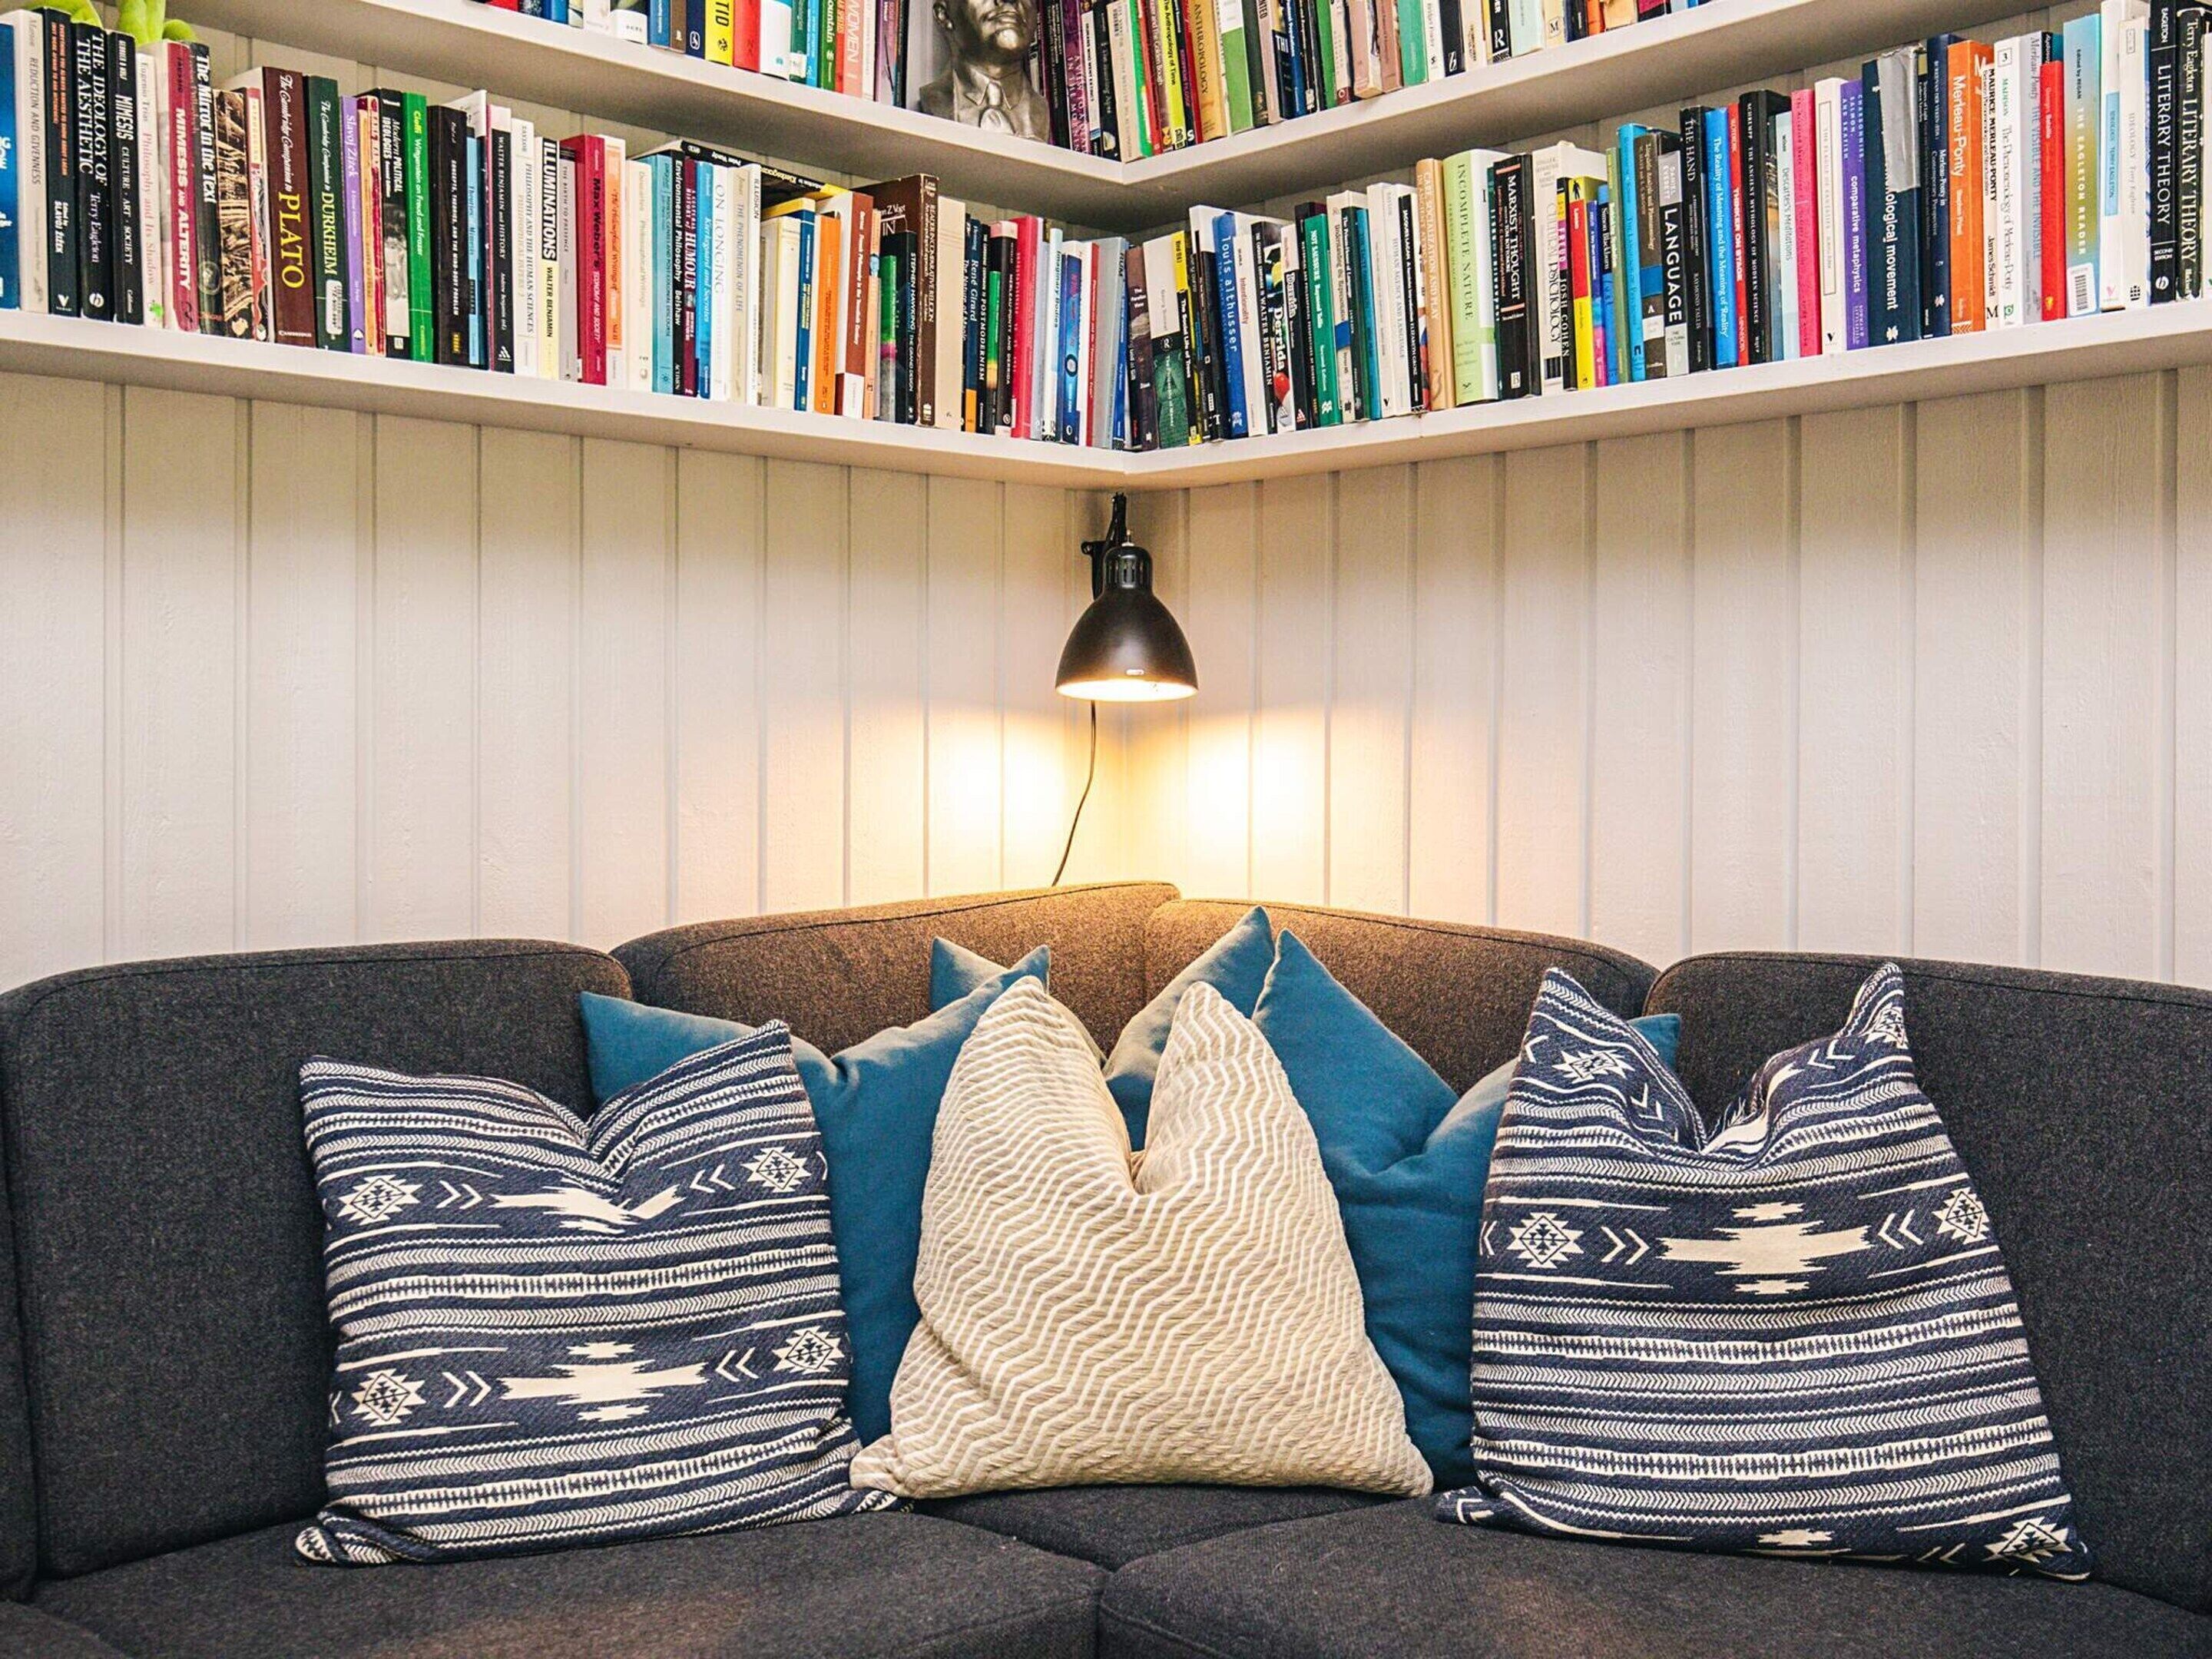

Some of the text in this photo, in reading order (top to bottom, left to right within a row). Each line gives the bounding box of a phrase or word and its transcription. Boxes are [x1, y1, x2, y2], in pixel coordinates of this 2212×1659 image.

[716, 2, 729, 27] TID
[847, 0, 859, 62] WOMEN
[1164, 12, 1174, 59] Anthropology
[1154, 41, 1163, 65] Golden
[1154, 65, 1164, 86] Bough
[1194, 4, 1210, 94] ANTHROPOLOGY
[2030, 38, 2040, 99] Merleau-Ponty
[2182, 18, 2198, 92] Terry Eagleton
[29, 58, 41, 185] REDUCTION AND GIVENNESS
[77, 38, 92, 174] THE AESTHETIC
[92, 33, 108, 186] THE IDEOLOGY OF
[115, 94, 134, 141] MIMESIS
[196, 55, 217, 203] The Mirror in the Text
[382, 117, 392, 157] IDEOLOGIES
[1952, 75, 1968, 176] Merleau-Ponty
[121, 147, 130, 189] CULTURE
[175, 108, 187, 187] MIMESIS
[1685, 120, 1696, 180] THE HAND
[1714, 154, 1723, 181] Reality
[2157, 65, 2171, 224] LITERARY THEORY
[543, 141, 556, 260] ILLUMINATIONS
[1717, 194, 1725, 227] Meaning
[2181, 99, 2197, 263] LITERARY THEORY
[55, 200, 65, 253] SLAVOJ ŽIŽEK
[90, 192, 101, 263] Terry Eagleton
[278, 191, 305, 288] PLATO
[322, 191, 337, 275] DURKHEIM
[714, 184, 724, 293] ON LONGING
[1458, 164, 1473, 320] INCOMPLETE NATURE
[1508, 175, 1521, 300] MARXIST THOUGHT
[1783, 167, 1793, 260] Descartes's Meditations
[1851, 176, 1861, 293] comparative metaphysics
[124, 226, 132, 264] SOCIETY
[179, 210, 190, 290] ALTERITY
[674, 230, 682, 282] Philosophy
[684, 232, 696, 290] HUMOUR
[970, 259, 979, 285] René
[1312, 246, 1320, 280] SAUSSURE
[1558, 228, 1567, 263] FREUD
[1603, 232, 1611, 270] Blackburn
[1664, 208, 1681, 322] LANGUAGE
[1751, 247, 1757, 257] OF
[1221, 237, 1237, 352] louis althusser
[1287, 273, 1296, 318] Derrida
[1886, 245, 1898, 310] movement
[1185, 349, 1190, 358] of
[1263, 337, 1273, 385] BENJAMIN
[1273, 307, 1286, 370] Derrida
[1561, 314, 1570, 357] COHEN
